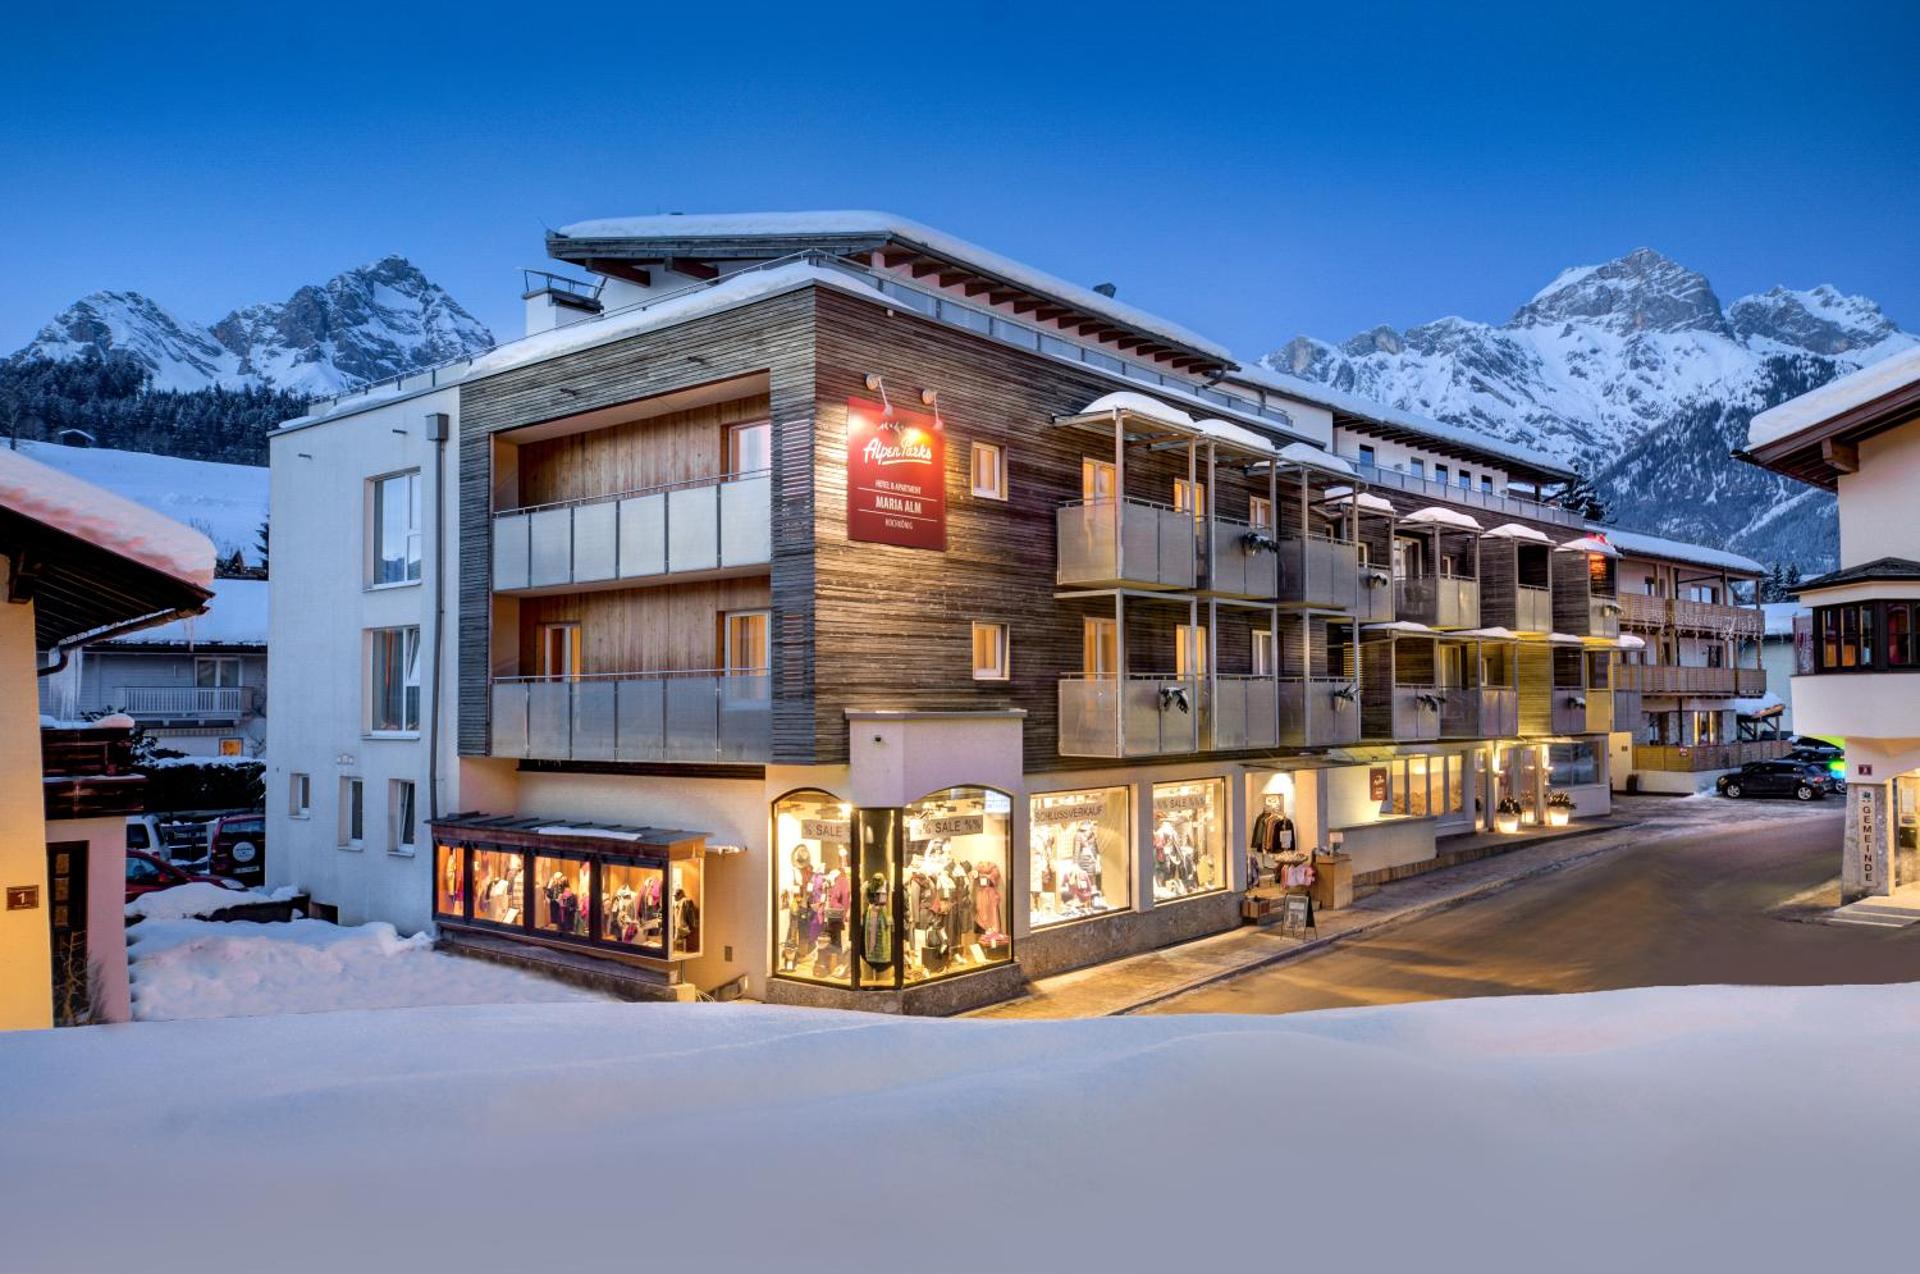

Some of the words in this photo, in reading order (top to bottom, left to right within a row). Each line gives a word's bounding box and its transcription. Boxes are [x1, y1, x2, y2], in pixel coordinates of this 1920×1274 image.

[876, 496, 903, 511] MARIA
[904, 500, 922, 514] ALM
[1169, 799, 1187, 808] SALE
[815, 824, 842, 837] SALE
[935, 820, 961, 833] SALE
[1862, 806, 1873, 882] GEMEINDE
[17, 892, 25, 904] 1
